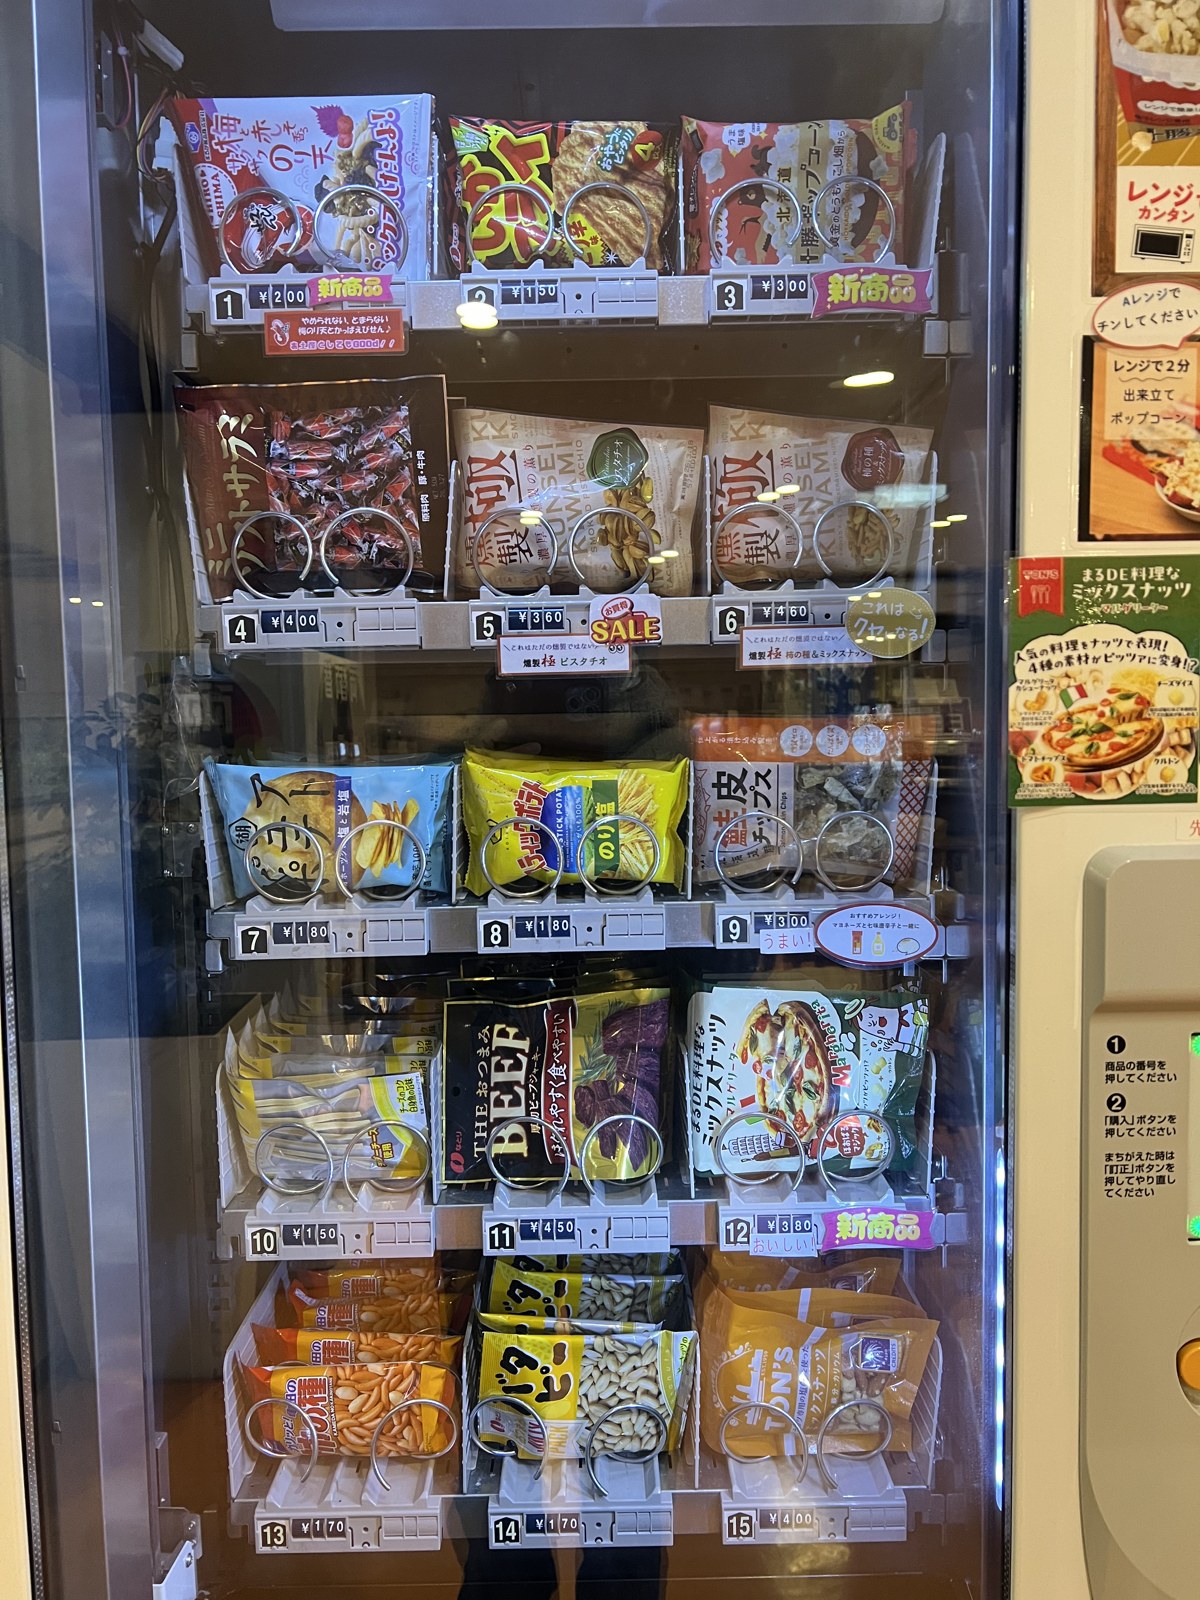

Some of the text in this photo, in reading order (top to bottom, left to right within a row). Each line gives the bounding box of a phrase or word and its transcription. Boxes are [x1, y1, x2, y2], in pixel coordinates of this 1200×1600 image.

[269, 140, 333, 171] のり天
[634, 142, 655, 161] 4
[776, 167, 792, 222] 北海道
[1128, 180, 1200, 208] レンジ
[1138, 205, 1195, 224] カンタン
[318, 277, 382, 298] 新商品
[512, 285, 555, 297] ¥150
[762, 279, 806, 292] ¥300
[828, 273, 917, 304] 新商品
[223, 294, 232, 316] 1
[259, 291, 304, 303] ¥200
[724, 285, 736, 308] 3
[1122, 287, 1181, 307] Aレンジで
[1097, 309, 1199, 333] チンしてください
[1113, 359, 1190, 373] レンジで2分
[1123, 389, 1175, 402] 出来立て
[1110, 411, 1186, 425] ポップコーン
[465, 450, 522, 532] 極
[712, 448, 779, 529] 極
[1082, 566, 1181, 582] まるDE料理な
[1072, 582, 1192, 600] ミックスナッツ
[518, 611, 562, 623] ¥360
[604, 600, 628, 616] お買得
[762, 605, 807, 618] ¥460
[862, 601, 905, 616] これは
[235, 619, 247, 640] 4
[271, 614, 316, 628] ¥400
[483, 617, 494, 637] 5
[725, 610, 737, 632] 6
[591, 618, 661, 643] SALE
[1015, 637, 1169, 663] 人気の料理をナッツで表現!
[780, 792, 788, 809] Chips
[235, 825, 251, 843] 湖
[525, 920, 569, 932] ¥180
[729, 919, 740, 941] 9
[764, 915, 808, 928] ¥300
[248, 930, 260, 951] 7
[283, 926, 327, 938] ¥180
[490, 924, 502, 945] 8
[764, 932, 811, 950] うまい!
[812, 999, 852, 1087] Margherita
[1105, 1060, 1167, 1072] 商品の番号を
[692, 1023, 705, 1133] まるDE料理な
[1105, 1072, 1177, 1084] 押してください
[473, 1026, 489, 1158] THE おつまみ
[489, 1023, 531, 1158] BEEF
[1104, 1114, 1177, 1126] 「購入」ボタンを
[1105, 1127, 1177, 1138] 押してください
[1104, 1151, 1175, 1162] まちがえた時は
[1104, 1163, 1175, 1174] 「訂正」ボタンを
[1104, 1175, 1176, 1187] 押してやり直し
[1104, 1187, 1155, 1198] てください
[292, 1228, 336, 1239] ¥150
[530, 1222, 574, 1233] ¥450
[726, 1223, 749, 1242] 12
[767, 1220, 811, 1232] ¥380
[837, 1211, 921, 1240] 新商品
[252, 1232, 274, 1252] 10
[491, 1227, 511, 1247] 11
[764, 1346, 793, 1431] TON'S
[301, 1521, 344, 1533] ¥170
[535, 1518, 577, 1530] ¥170
[729, 1516, 751, 1537] 15
[769, 1513, 812, 1525] ¥400
[262, 1525, 285, 1546] 13
[494, 1521, 517, 1542] 14
